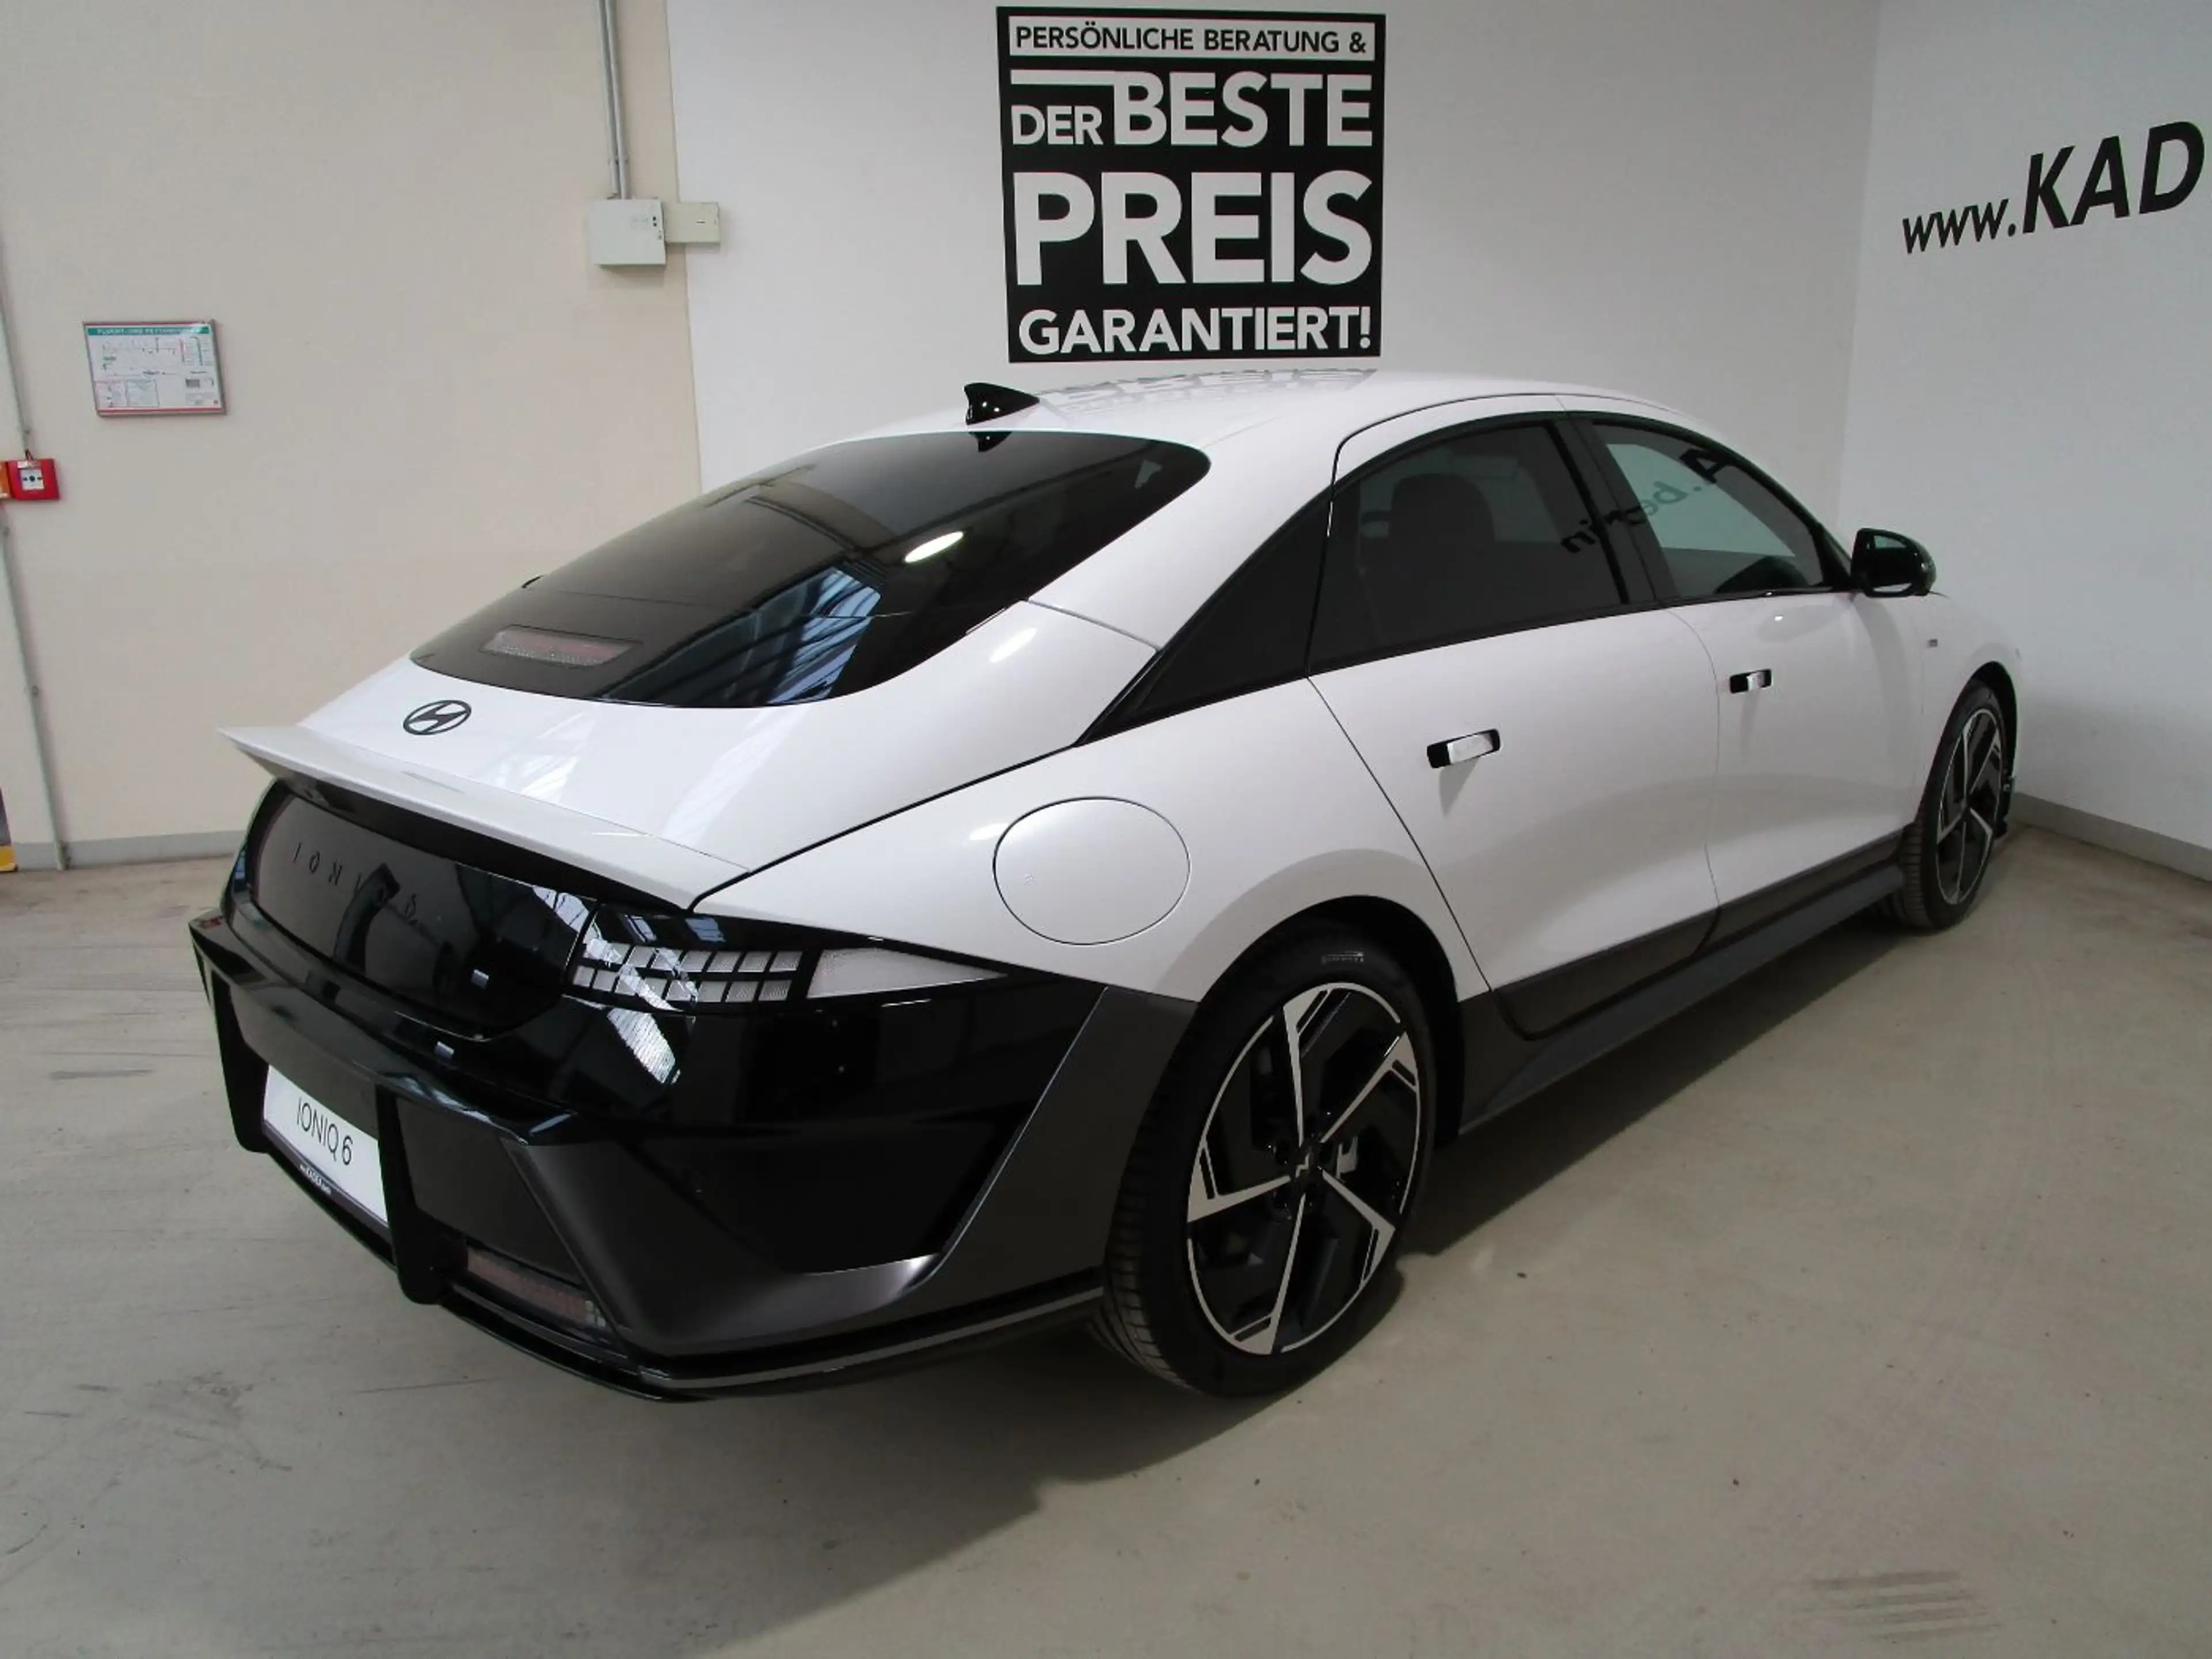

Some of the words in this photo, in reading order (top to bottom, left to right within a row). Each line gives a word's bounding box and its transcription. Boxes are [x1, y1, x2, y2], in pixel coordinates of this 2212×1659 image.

[1016, 21, 1194, 51] PERSÖNLICHE
[1203, 29, 1339, 53] BERATUNG
[1349, 31, 1367, 54] &
[1011, 105, 1104, 145] DER
[1113, 70, 1373, 147] BESTE
[1902, 121, 2205, 255] www.KAD
[1013, 169, 1373, 286] PREIS
[1018, 306, 1372, 355] GARANTIERT!
[296, 1097, 340, 1162] IONIQ
[341, 1135, 354, 1166] 6
